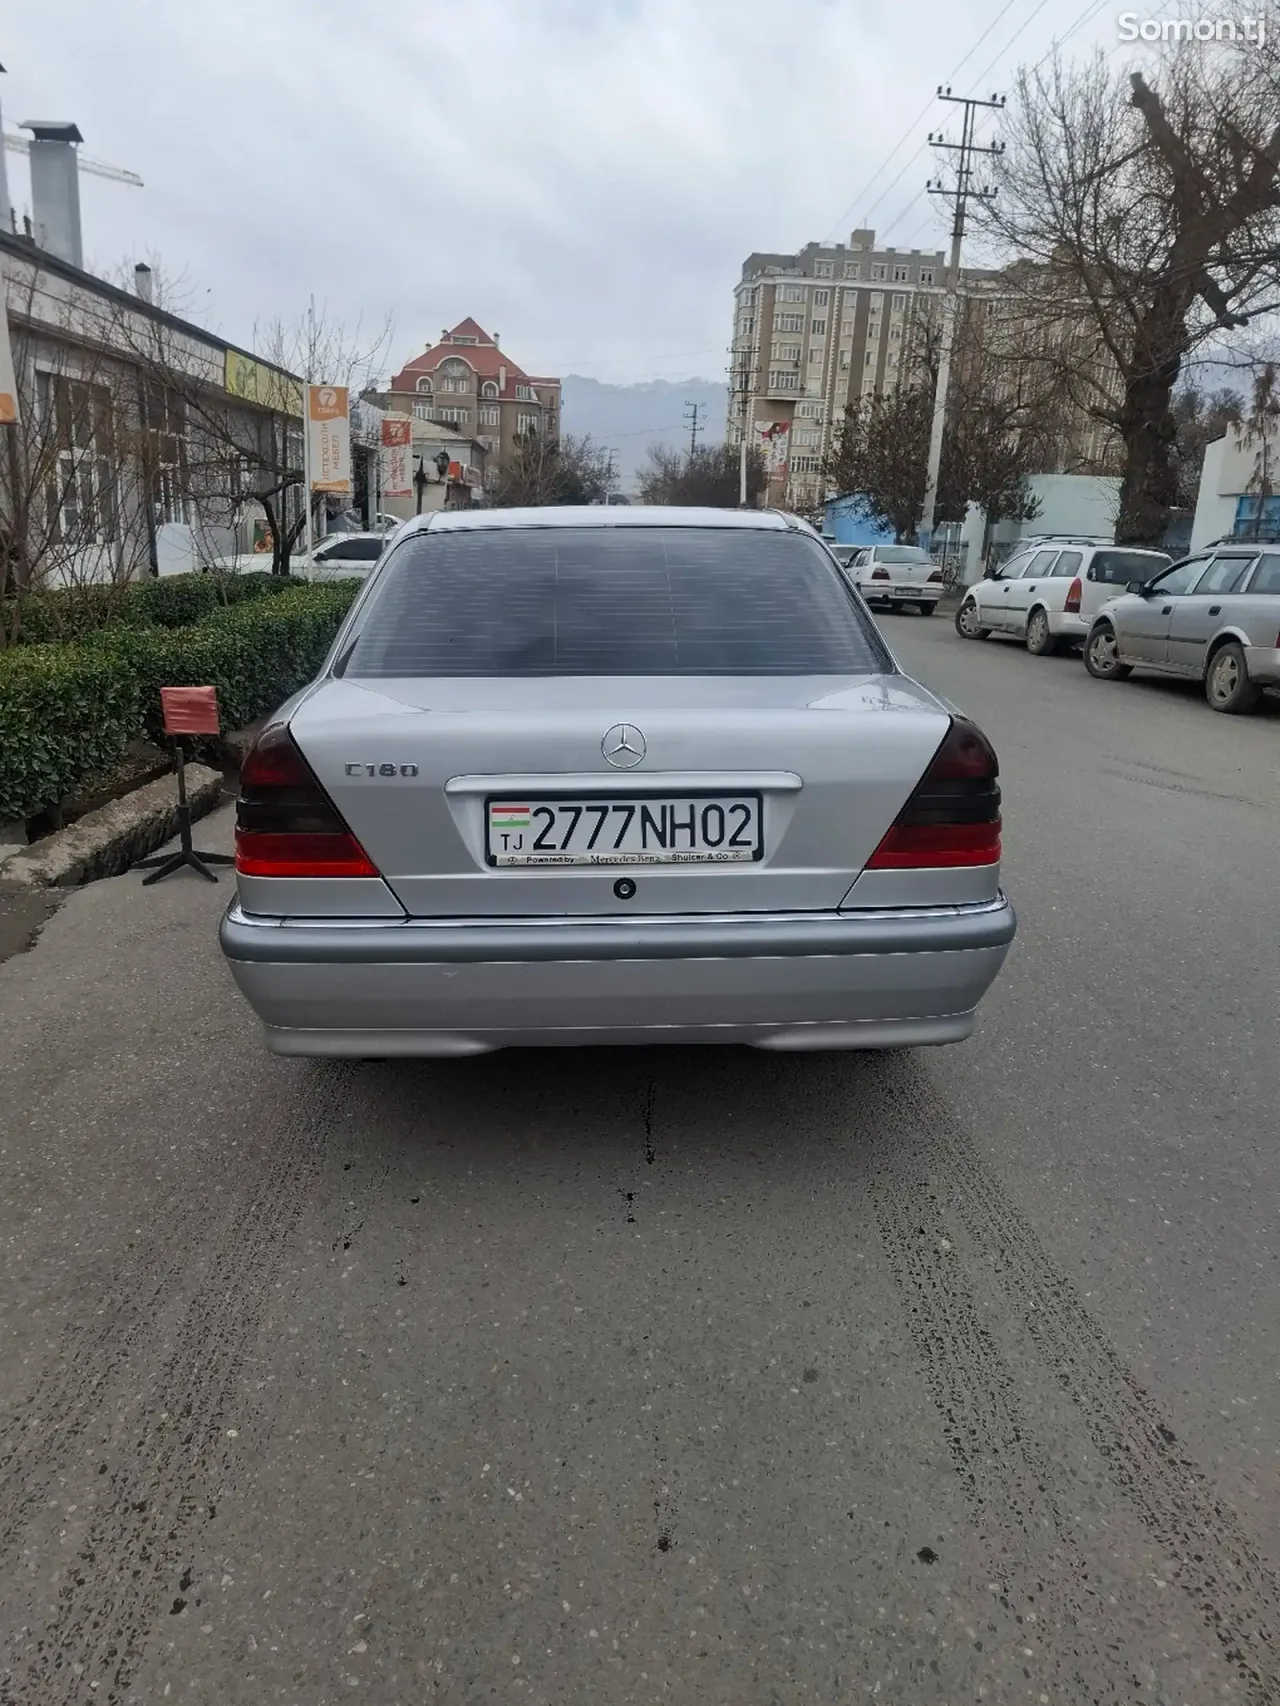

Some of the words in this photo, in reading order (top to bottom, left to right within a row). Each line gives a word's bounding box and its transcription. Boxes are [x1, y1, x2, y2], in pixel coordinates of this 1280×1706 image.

[344, 761, 419, 777] C180
[532, 803, 753, 851] 2777NH02
[500, 833, 523, 851] TJ
[564, 856, 574, 864] by
[707, 852, 714, 860] &
[716, 852, 729, 860] Co
